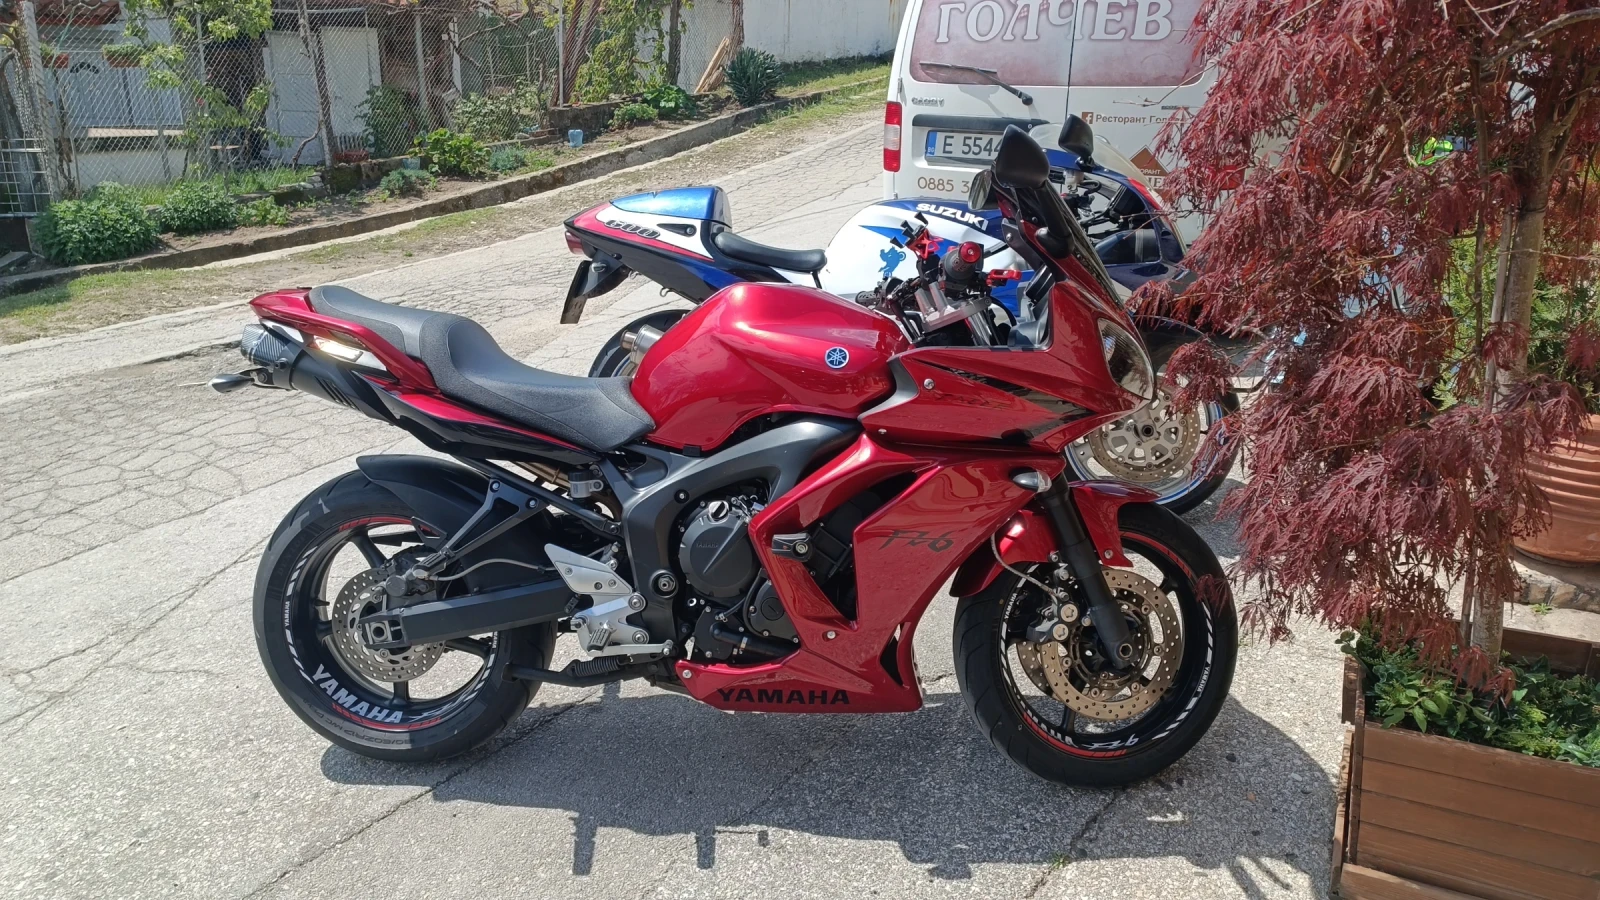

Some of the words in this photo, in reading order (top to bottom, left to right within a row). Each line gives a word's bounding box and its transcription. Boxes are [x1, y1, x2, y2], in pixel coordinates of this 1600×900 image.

[936, 0, 1173, 42] ГОЛЧЕВ
[1095, 114, 1147, 125] Ресторант
[942, 135, 954, 154] E
[917, 176, 954, 192] 0885
[915, 203, 989, 231] SUZUKI
[604, 219, 660, 239] 600
[878, 530, 956, 552] FZ6
[1004, 593, 1018, 619] YAMAHA
[1196, 666, 1210, 692] YAMAHA
[312, 663, 403, 723] YAMAHA
[717, 687, 850, 704] YAMAHA
